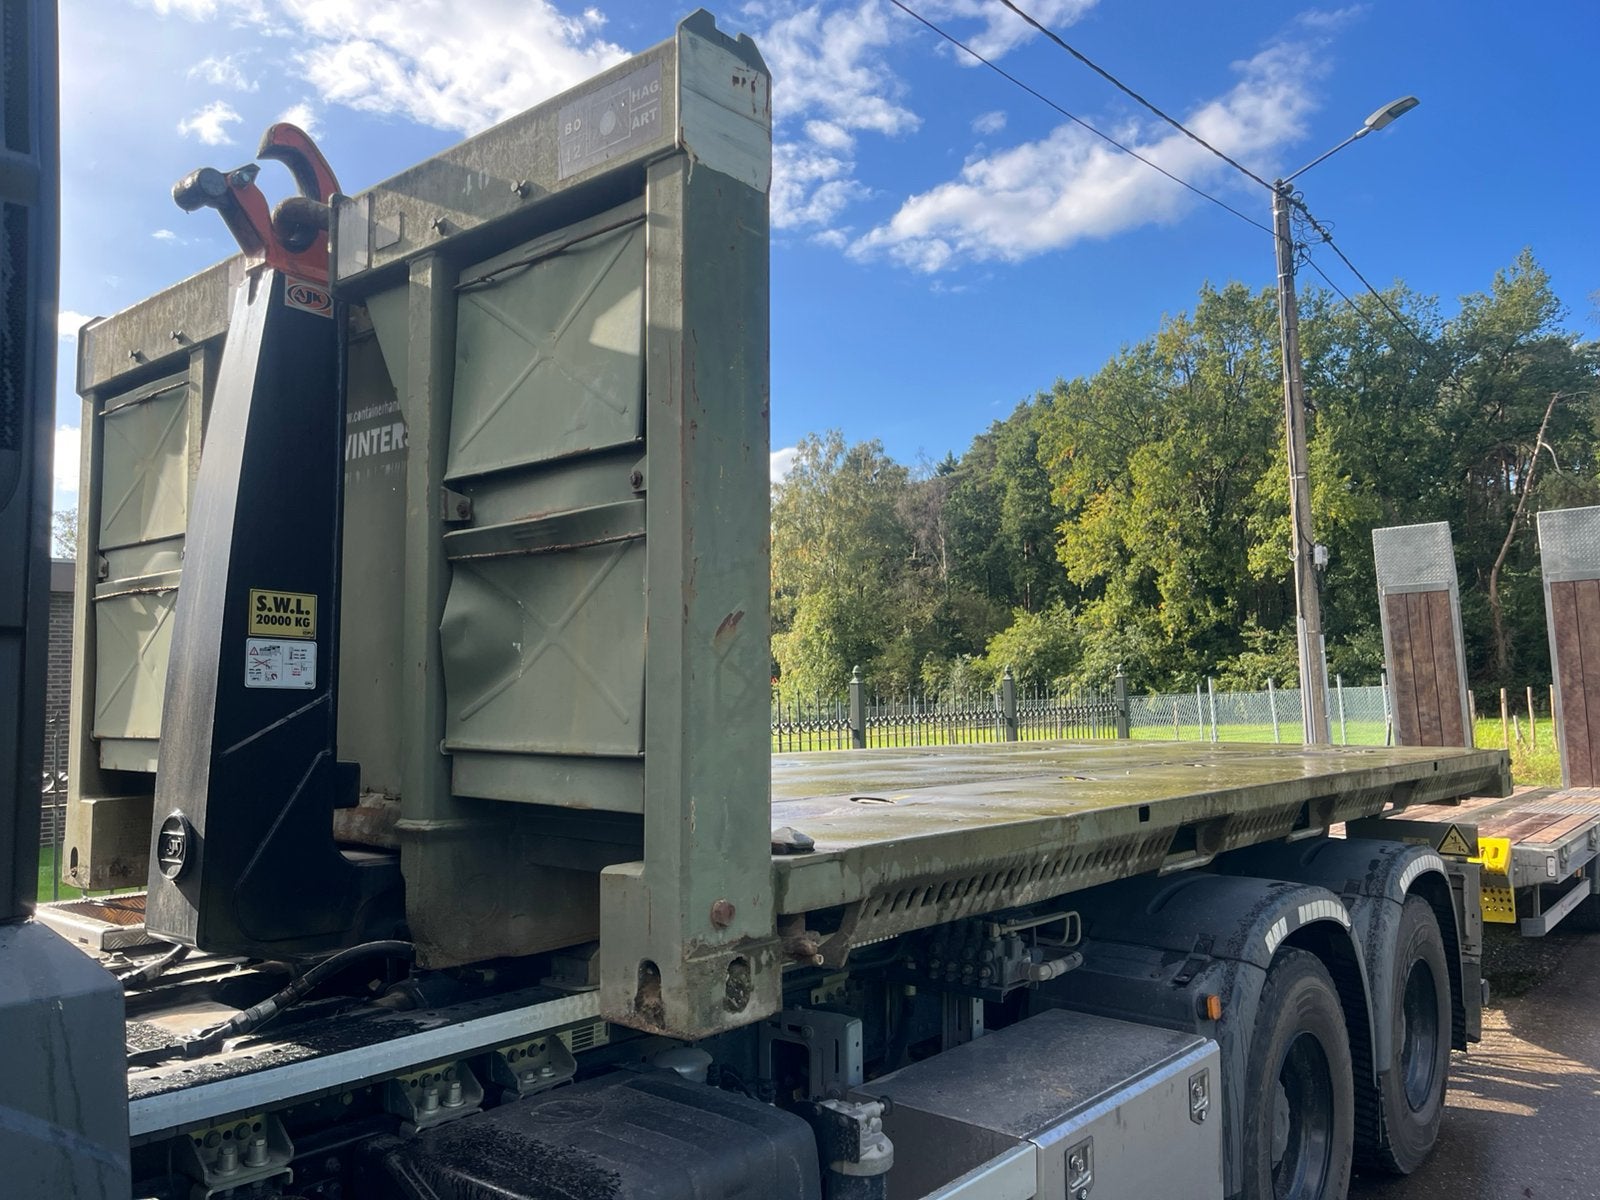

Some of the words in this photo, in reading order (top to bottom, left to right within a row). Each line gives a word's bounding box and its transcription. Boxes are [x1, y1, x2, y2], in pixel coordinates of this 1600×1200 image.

[632, 107, 658, 130] ART
[256, 594, 311, 616] S.W.L.
[256, 613, 292, 627] 20000
[295, 616, 311, 628] KG
